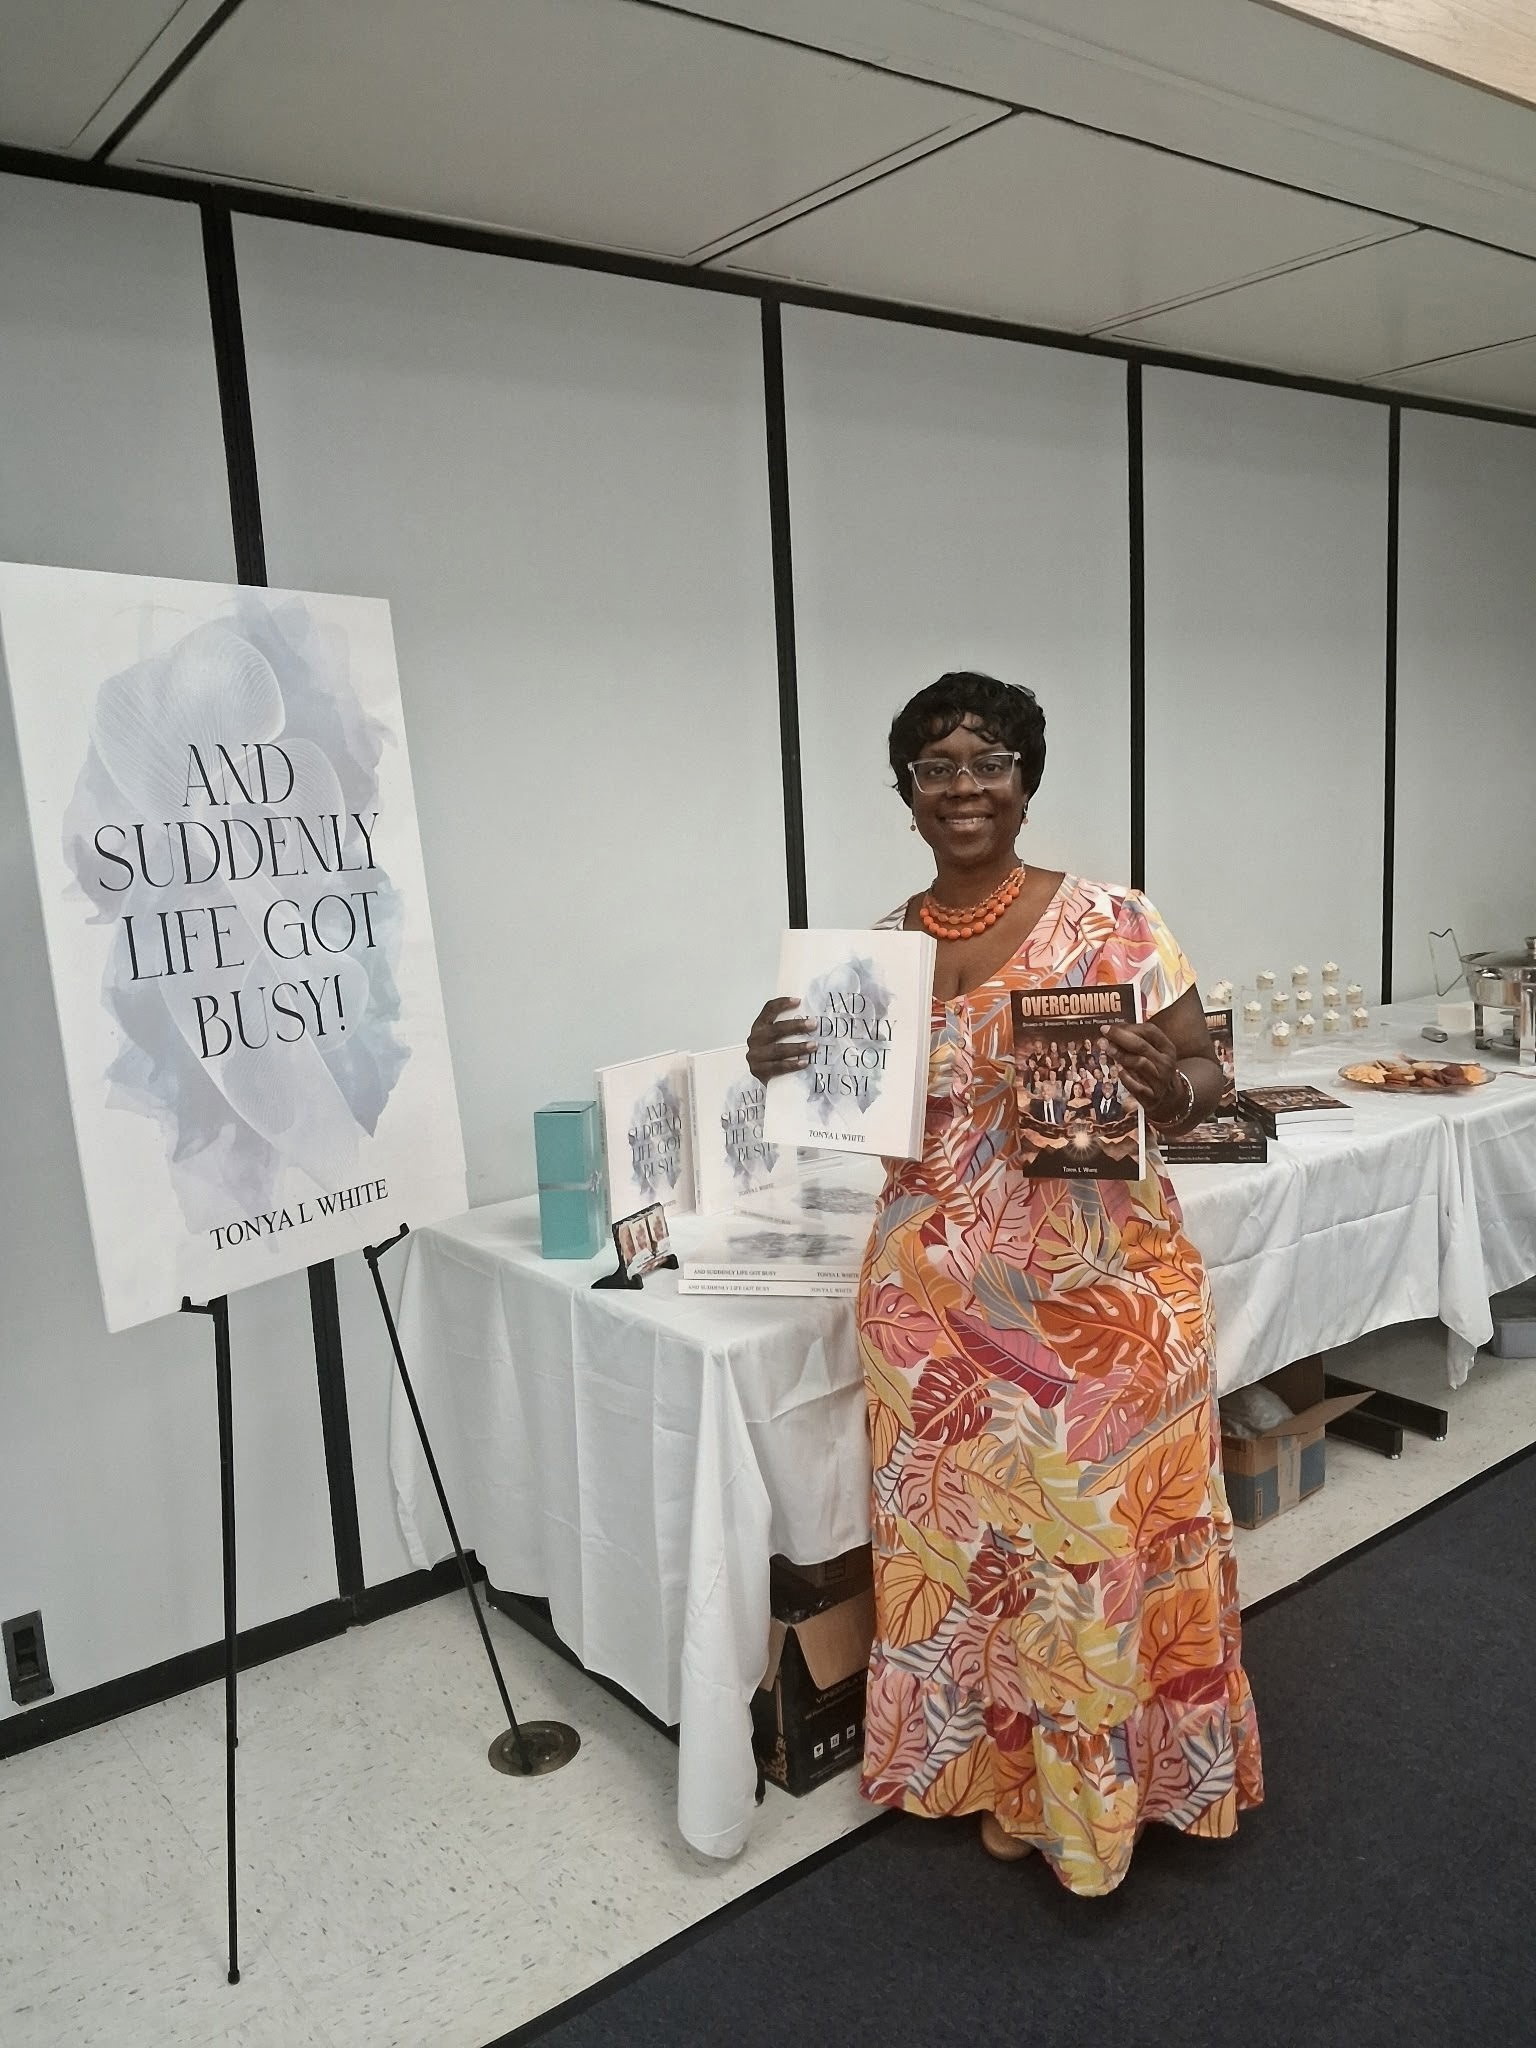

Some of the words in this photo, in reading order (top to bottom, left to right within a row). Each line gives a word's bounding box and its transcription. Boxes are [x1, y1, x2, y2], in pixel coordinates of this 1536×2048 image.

[182, 743, 294, 808] AND
[94, 812, 380, 892] SUDDENLY
[121, 904, 245, 981] LIFE
[263, 891, 379, 960] GOT
[824, 991, 866, 1014] AND
[1021, 991, 1121, 1017] OVERCOMING
[192, 975, 347, 1060] BUSY!
[793, 1015, 897, 1041] DDENLY
[842, 1046, 892, 1070] GOT
[814, 1072, 869, 1098] BUSY!
[809, 1129, 834, 1140] TONYA
[841, 1133, 866, 1143] WHITE
[209, 1208, 295, 1250] TONYA
[297, 1202, 313, 1224] L
[316, 1178, 389, 1217] WHITE
